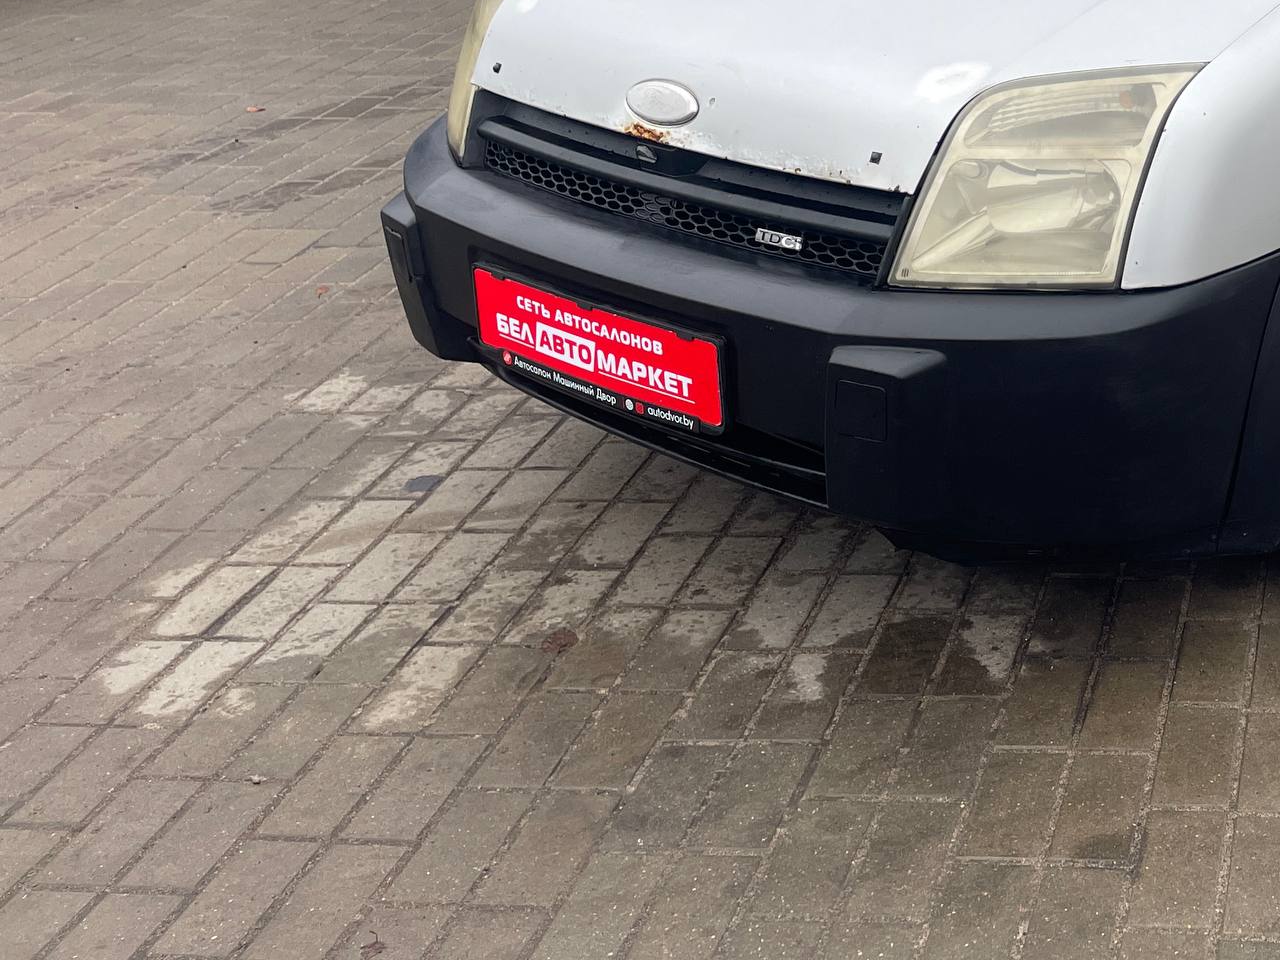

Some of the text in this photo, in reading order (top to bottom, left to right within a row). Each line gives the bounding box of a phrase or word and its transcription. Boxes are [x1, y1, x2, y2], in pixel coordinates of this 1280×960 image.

[516, 295, 664, 356] СЕТЬ АВТОСАЛОНОВ
[496, 312, 693, 398] БЕЛ АВТО МАРКЕТ
[514, 356, 617, 406] Автосалон Машинный Двор
[647, 406, 694, 430] autodvor.by
